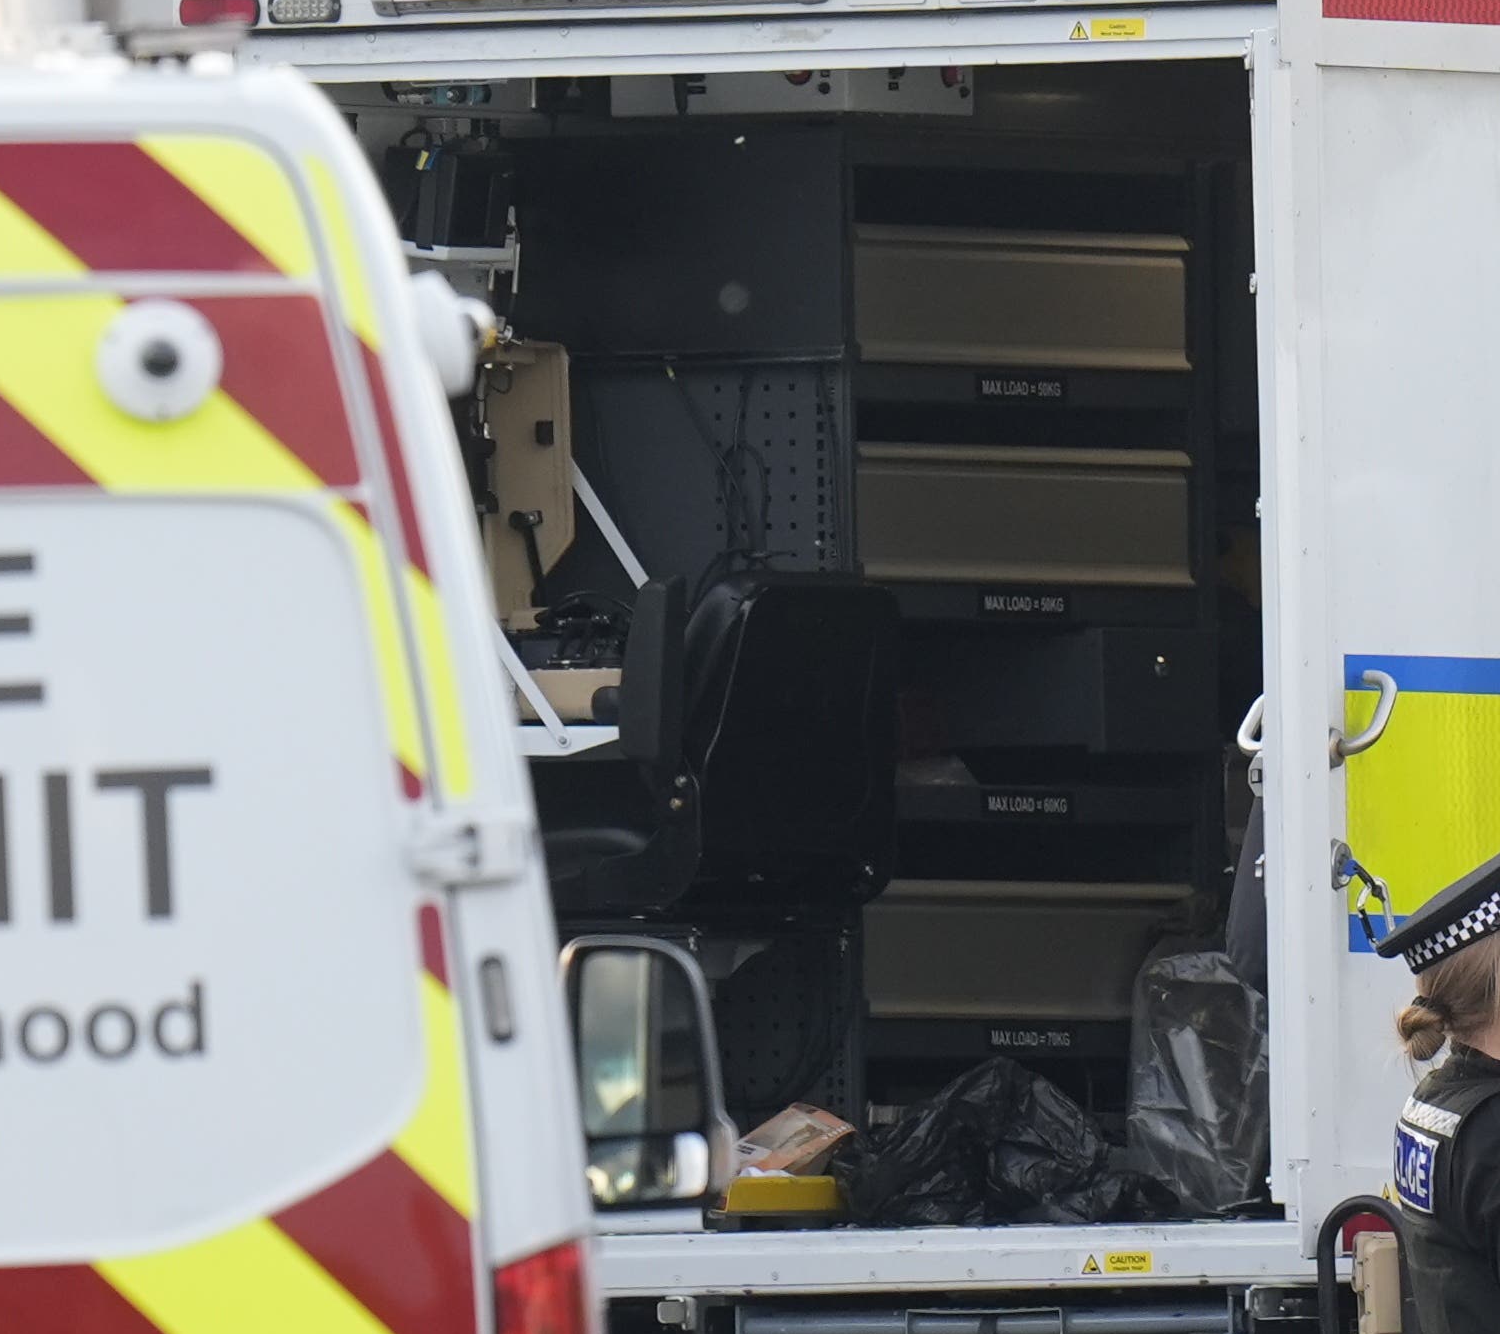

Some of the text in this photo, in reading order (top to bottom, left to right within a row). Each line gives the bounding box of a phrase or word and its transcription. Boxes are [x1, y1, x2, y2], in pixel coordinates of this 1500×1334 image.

[982, 380, 1003, 395] MAX
[1003, 381, 1029, 395] LOAD
[984, 596, 1006, 611] MAX
[1006, 596, 1032, 612] LOAD
[988, 795, 1008, 811] MAX
[1009, 796, 1035, 812] LOAD
[991, 1030, 1011, 1045] MAX
[1013, 1031, 1038, 1046] LOAD
[1109, 1255, 1146, 1264] CAUTION
